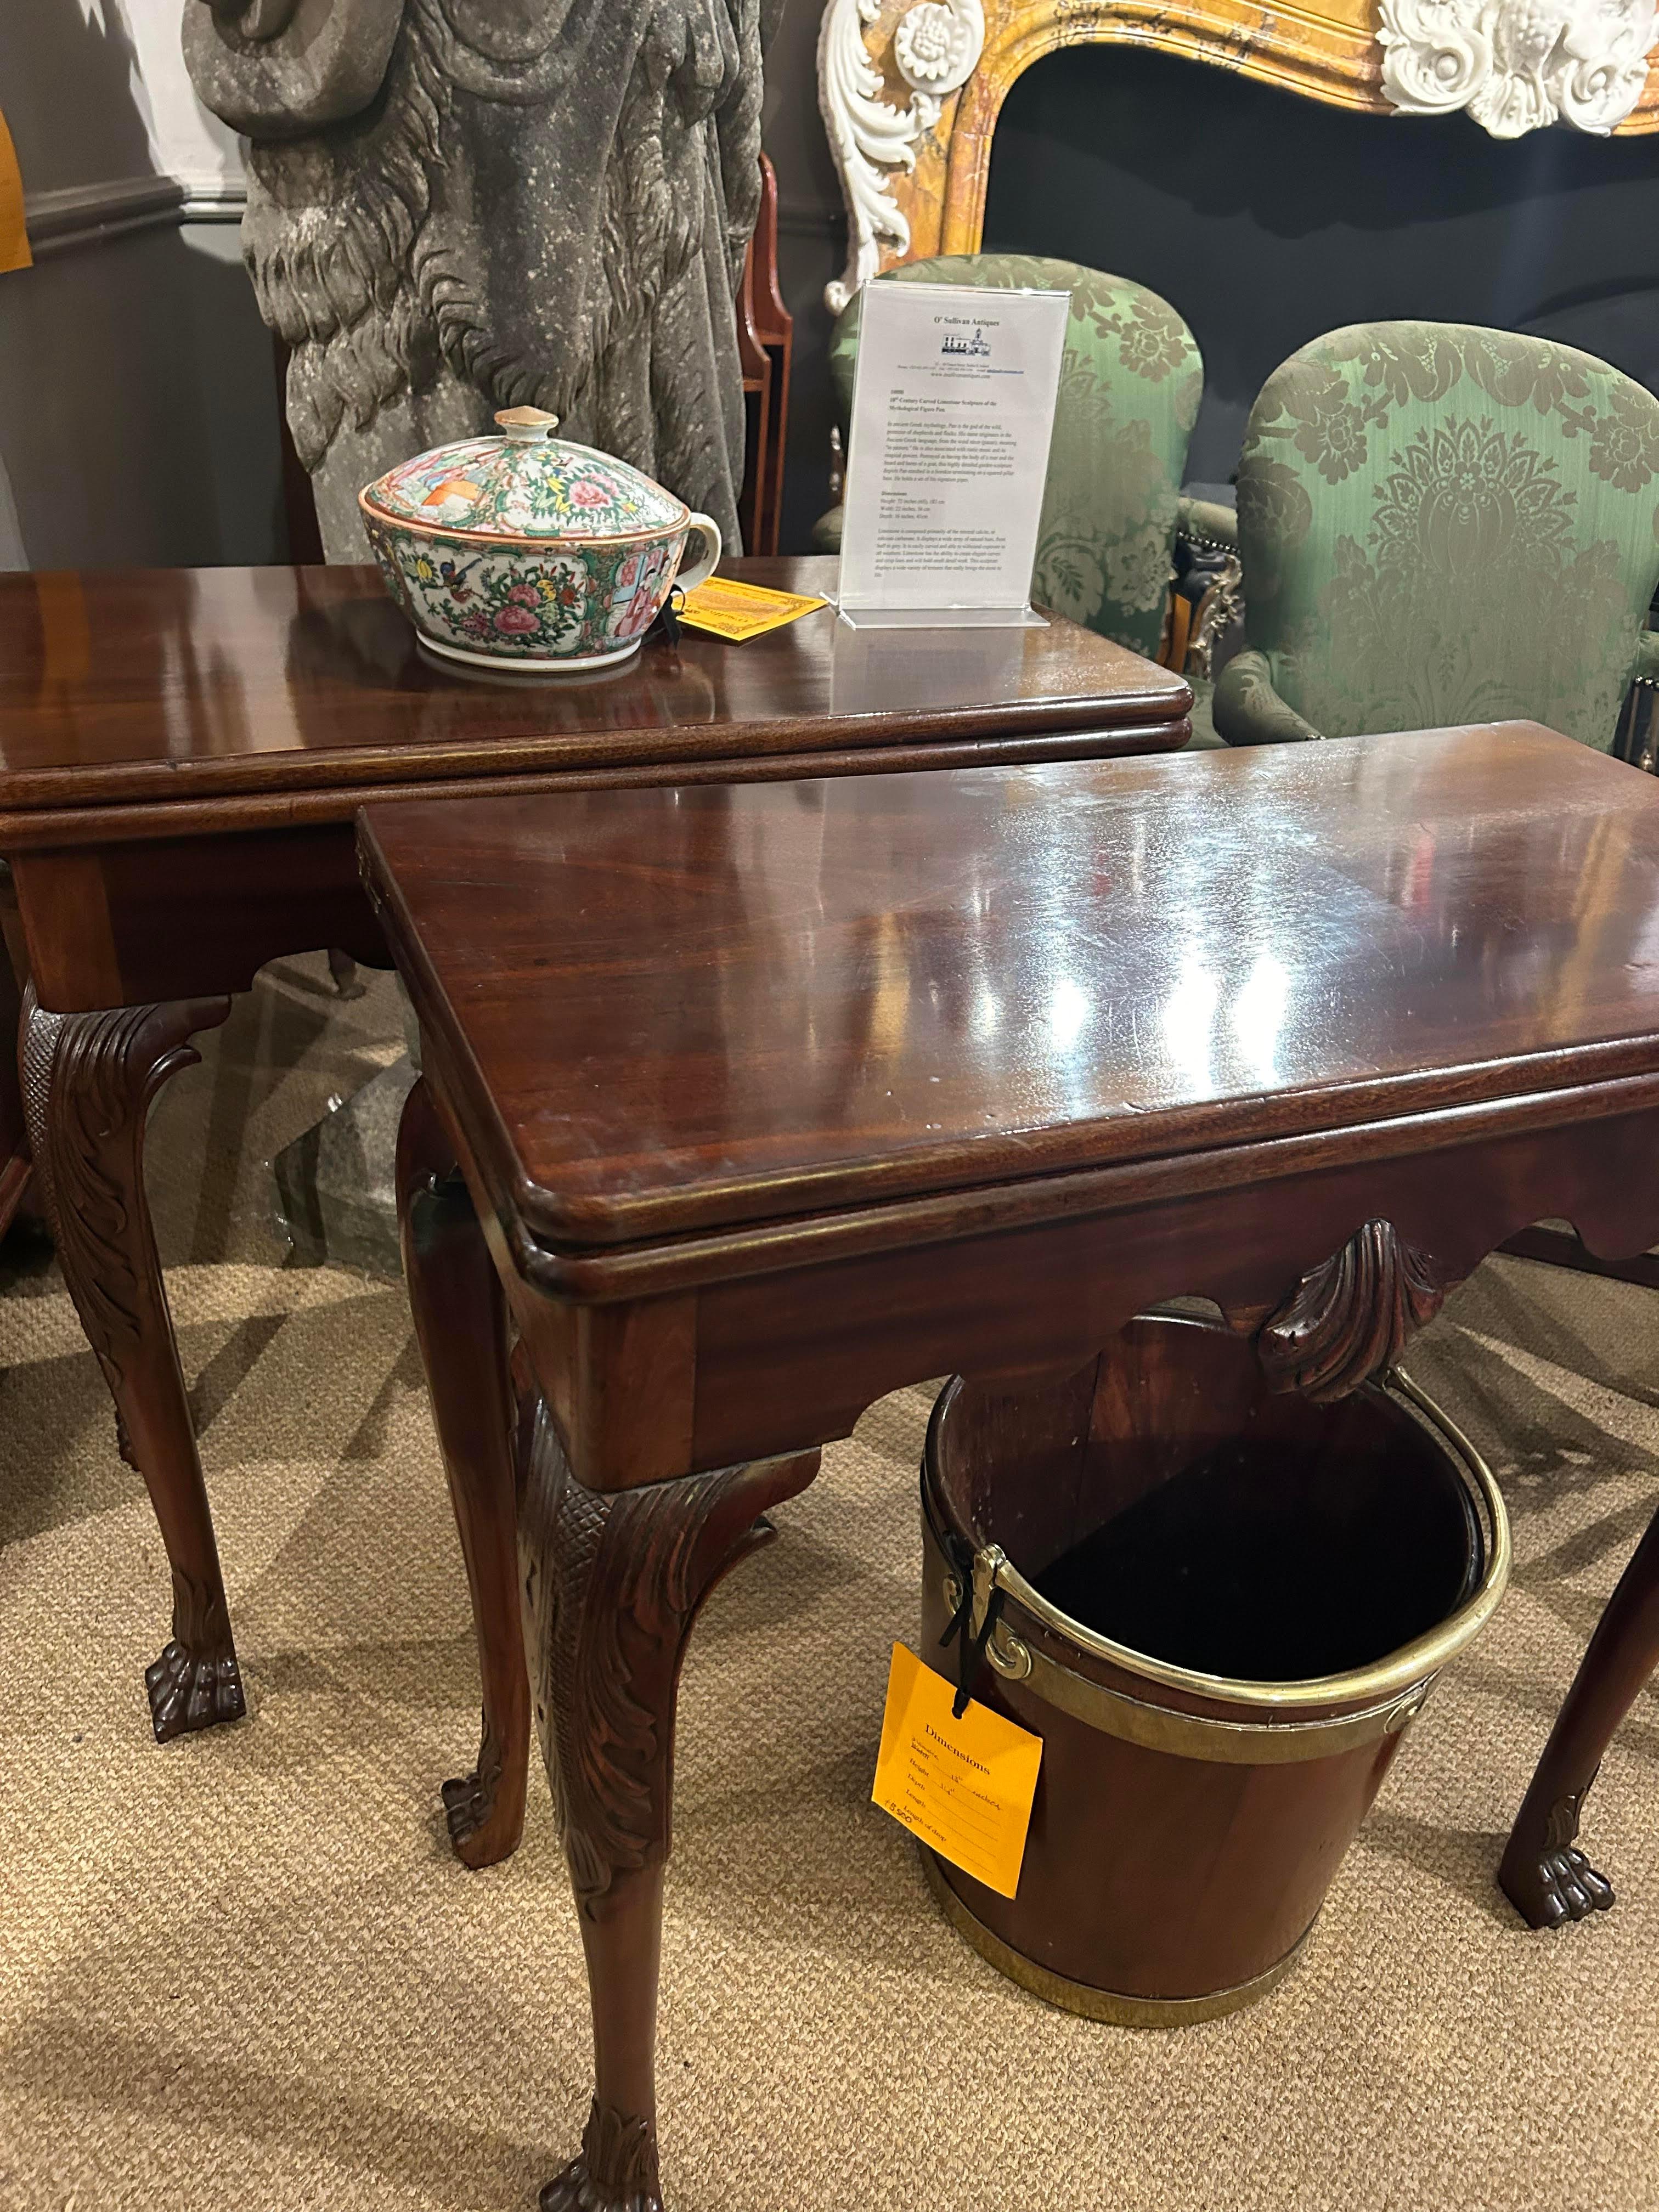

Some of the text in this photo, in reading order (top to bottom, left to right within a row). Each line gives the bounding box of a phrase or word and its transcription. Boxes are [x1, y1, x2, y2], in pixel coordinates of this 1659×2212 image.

[971, 318, 1000, 327] Antiques
[926, 1723, 990, 1775] Dimensions
[910, 1758, 929, 1778] Height
[907, 1773, 926, 1791] Depth
[906, 1789, 926, 1808] Length
[904, 1805, 923, 1824] Length
[932, 1829, 946, 1842] drop
